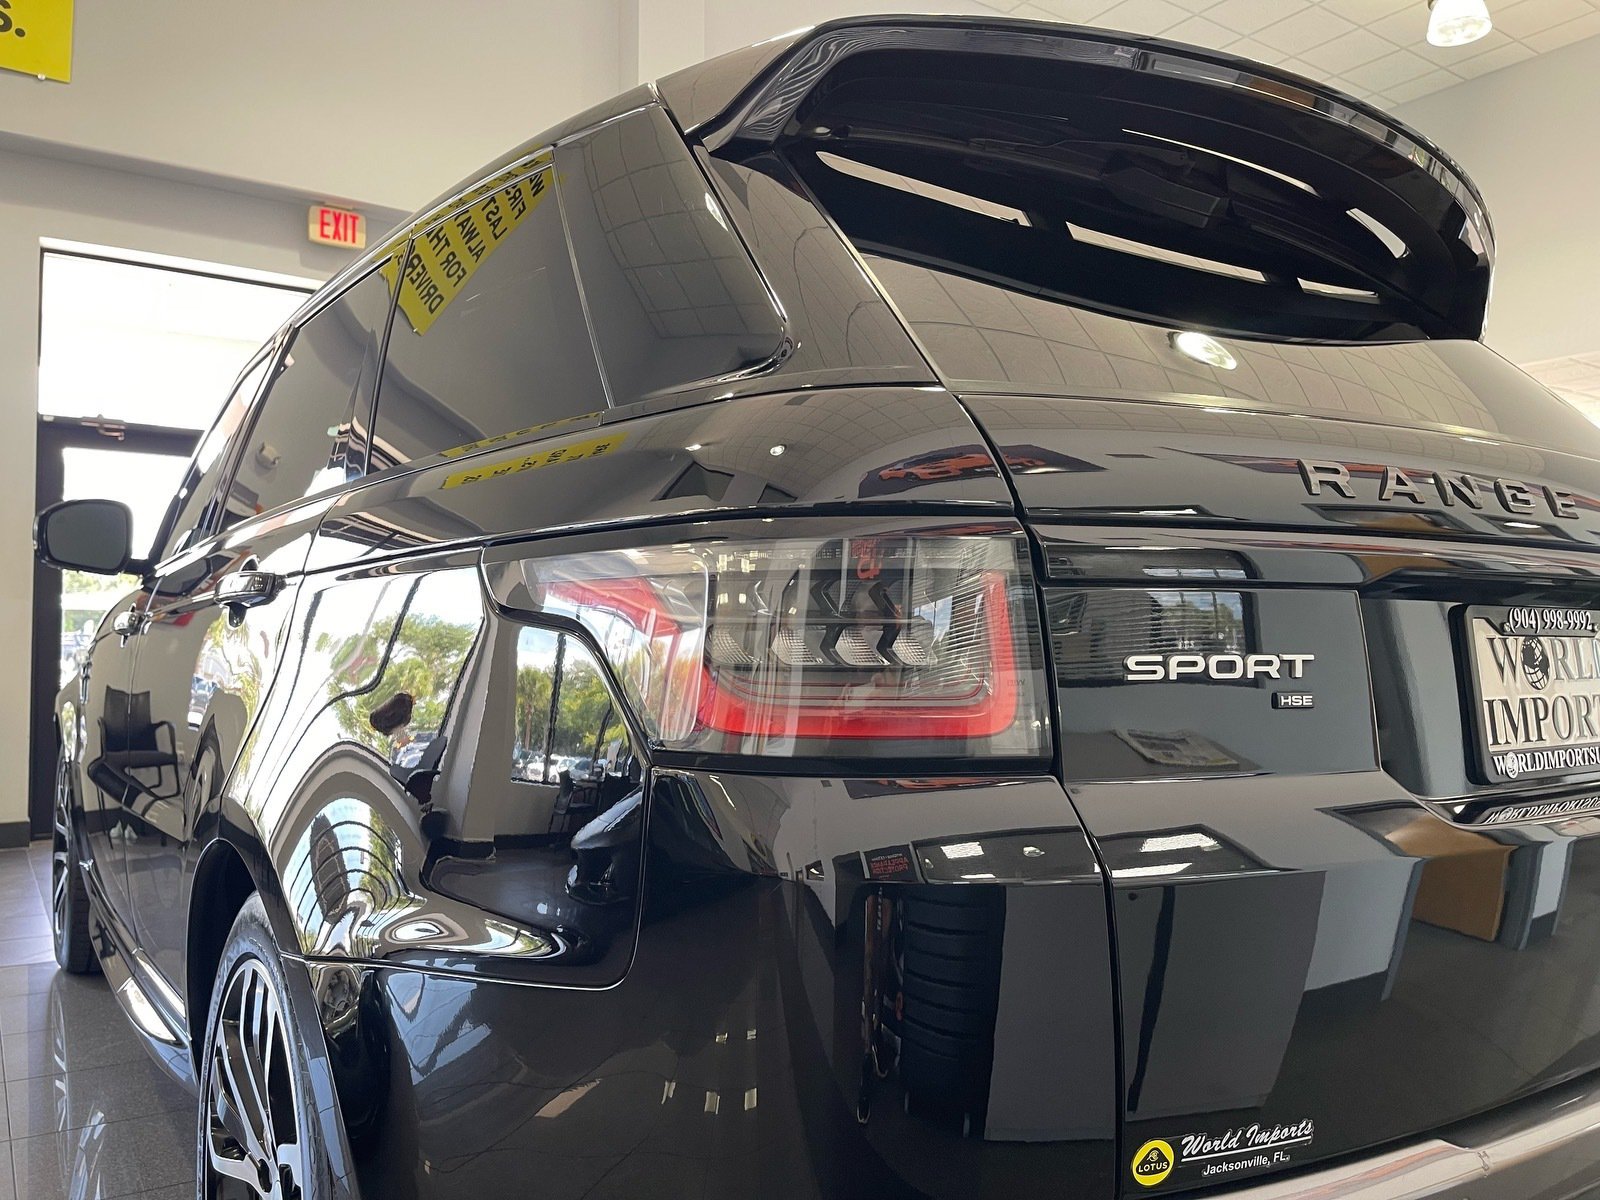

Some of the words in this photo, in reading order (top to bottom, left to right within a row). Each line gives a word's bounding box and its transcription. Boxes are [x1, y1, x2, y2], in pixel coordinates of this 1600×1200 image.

[320, 209, 359, 244] EXIT
[1297, 458, 1580, 519] RANGE
[1508, 607, 1541, 634] (904)
[1542, 609, 1593, 631] 998-9992
[1123, 653, 1315, 681] SPORT
[1280, 695, 1313, 706] HSE
[1181, 1129, 1243, 1157] World
[1246, 1119, 1313, 1146] Imports
[1138, 1161, 1168, 1173] LOTUS
[1203, 1156, 1271, 1176] Jacksonville,
